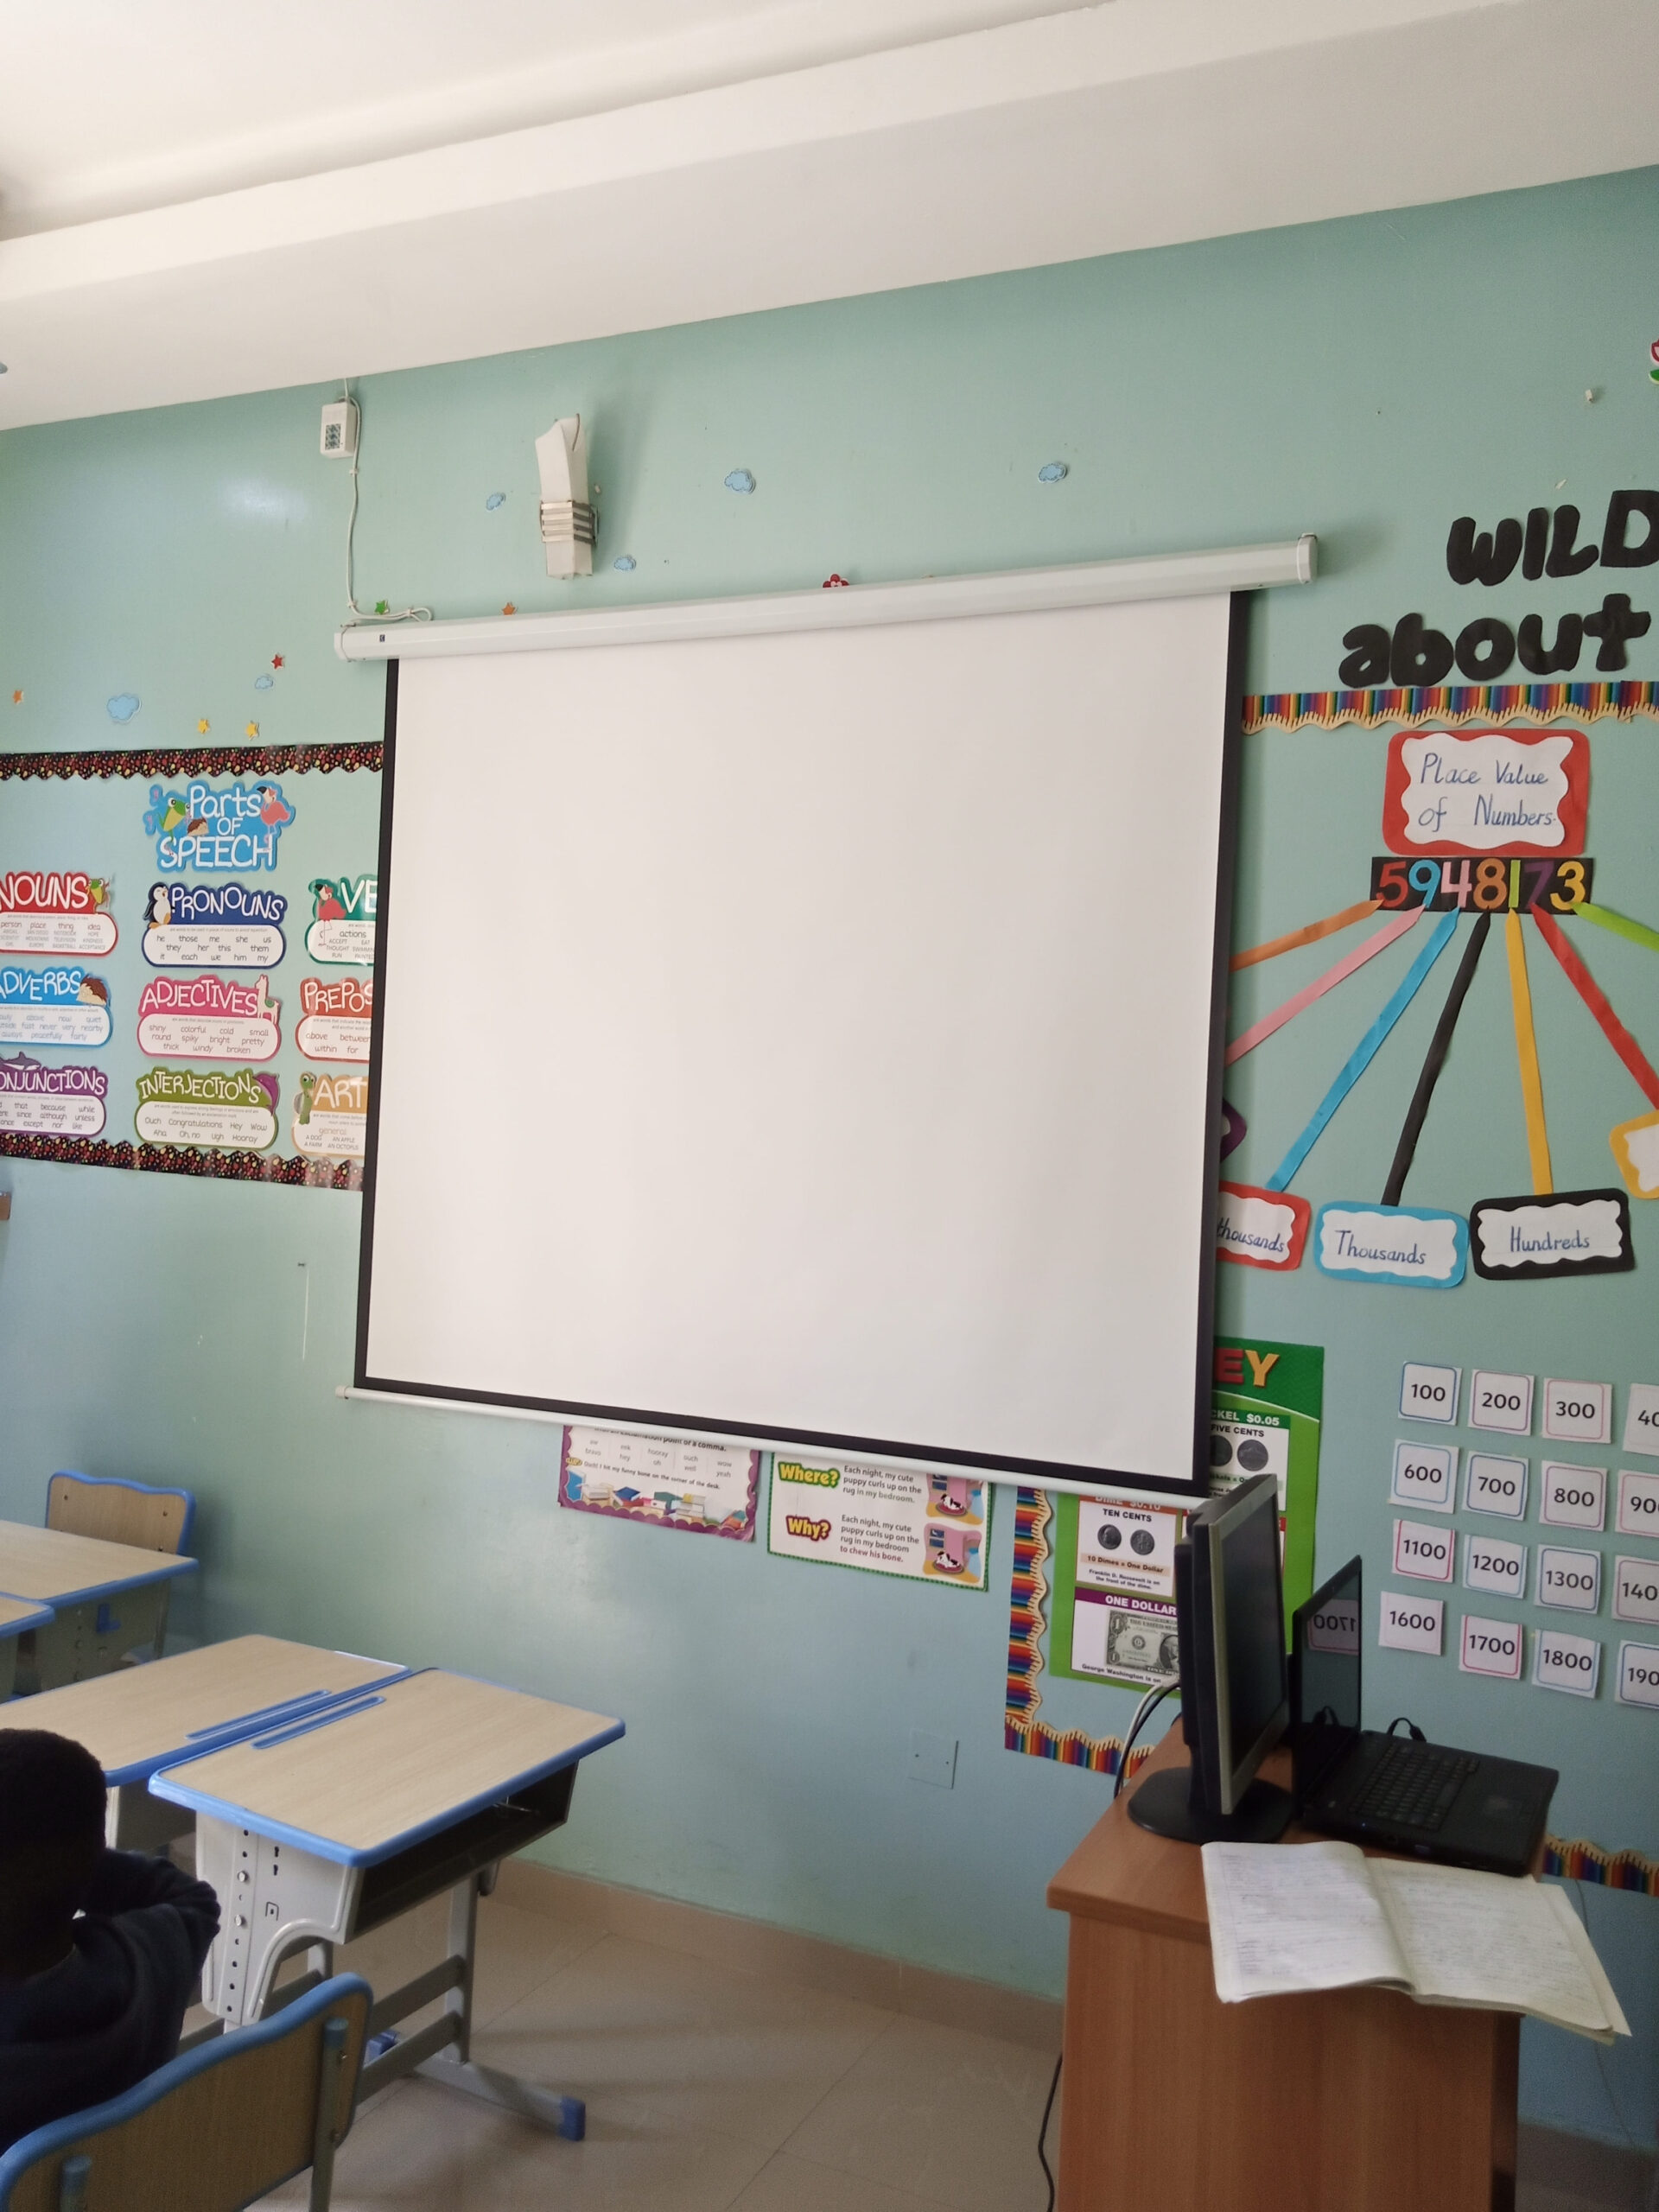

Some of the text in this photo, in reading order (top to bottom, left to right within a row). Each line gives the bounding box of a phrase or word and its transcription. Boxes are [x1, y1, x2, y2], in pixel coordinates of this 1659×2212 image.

[1446, 489, 1659, 587] WILD
[1339, 593, 1651, 688] about
[1421, 753, 1548, 785] Place Value
[190, 785, 261, 818] Parts
[1418, 797, 1447, 832] of
[217, 817, 243, 836] OF
[160, 835, 273, 868] SPEECH
[0, 875, 88, 911] NOUNS
[172, 887, 283, 920] PRONOUNS
[58, 923, 73, 931] thing
[142, 980, 257, 1015] ADJECTIVES
[210, 1037, 230, 1046] bright
[139, 1071, 261, 1103] INTERJECTIONS
[314, 1078, 367, 1109] ART
[41, 1113, 67, 1122] although
[168, 1118, 222, 1128] Congratulations
[231, 1122, 243, 1131] Hey
[1217, 1217, 1284, 1252] thousands
[1510, 1225, 1591, 1252] Hundreds
[1334, 1230, 1426, 1265] Thousands
[1411, 1383, 1446, 1402] 100
[1482, 1392, 1521, 1411] 200
[1556, 1401, 1595, 1419] 300
[1211, 1424, 1264, 1437] FIVE CENTS
[1247, 1414, 1281, 1427] $0.05
[698, 1442, 726, 1451] comma.
[780, 1464, 838, 1486] Where?
[844, 1465, 861, 1474] Each
[862, 1467, 883, 1478] night,
[843, 1477, 867, 1486] puppy
[868, 1478, 885, 1488] curls
[909, 1484, 922, 1494] the
[1404, 1465, 1659, 1514] 600 700 800 90
[879, 1491, 915, 1503] bedroom.
[842, 1515, 858, 1524] Each
[860, 1518, 880, 1529] night,
[882, 1522, 893, 1532] my
[1103, 1508, 1152, 1522] TEN CENTS
[787, 1517, 830, 1540] Why?
[841, 1526, 864, 1536] puppy
[866, 1529, 883, 1538] curls
[885, 1533, 893, 1541] up
[907, 1535, 919, 1544] the
[841, 1536, 853, 1545] rug
[863, 1540, 874, 1548] my
[875, 1541, 909, 1553] bedroom
[849, 1547, 868, 1556] chew
[870, 1550, 880, 1559] his
[882, 1552, 903, 1562] bone.
[1098, 1557, 1119, 1566] Dimes
[1403, 1539, 1446, 1560] 1100
[1472, 1554, 1519, 1576] 1200
[1545, 1570, 1593, 1591] 1300
[1105, 1595, 1177, 1615] ONE DOLLAR
[1389, 1611, 1435, 1632] 1600
[1469, 1635, 1516, 1656] 1700
[1542, 1649, 1592, 1671] 1800
